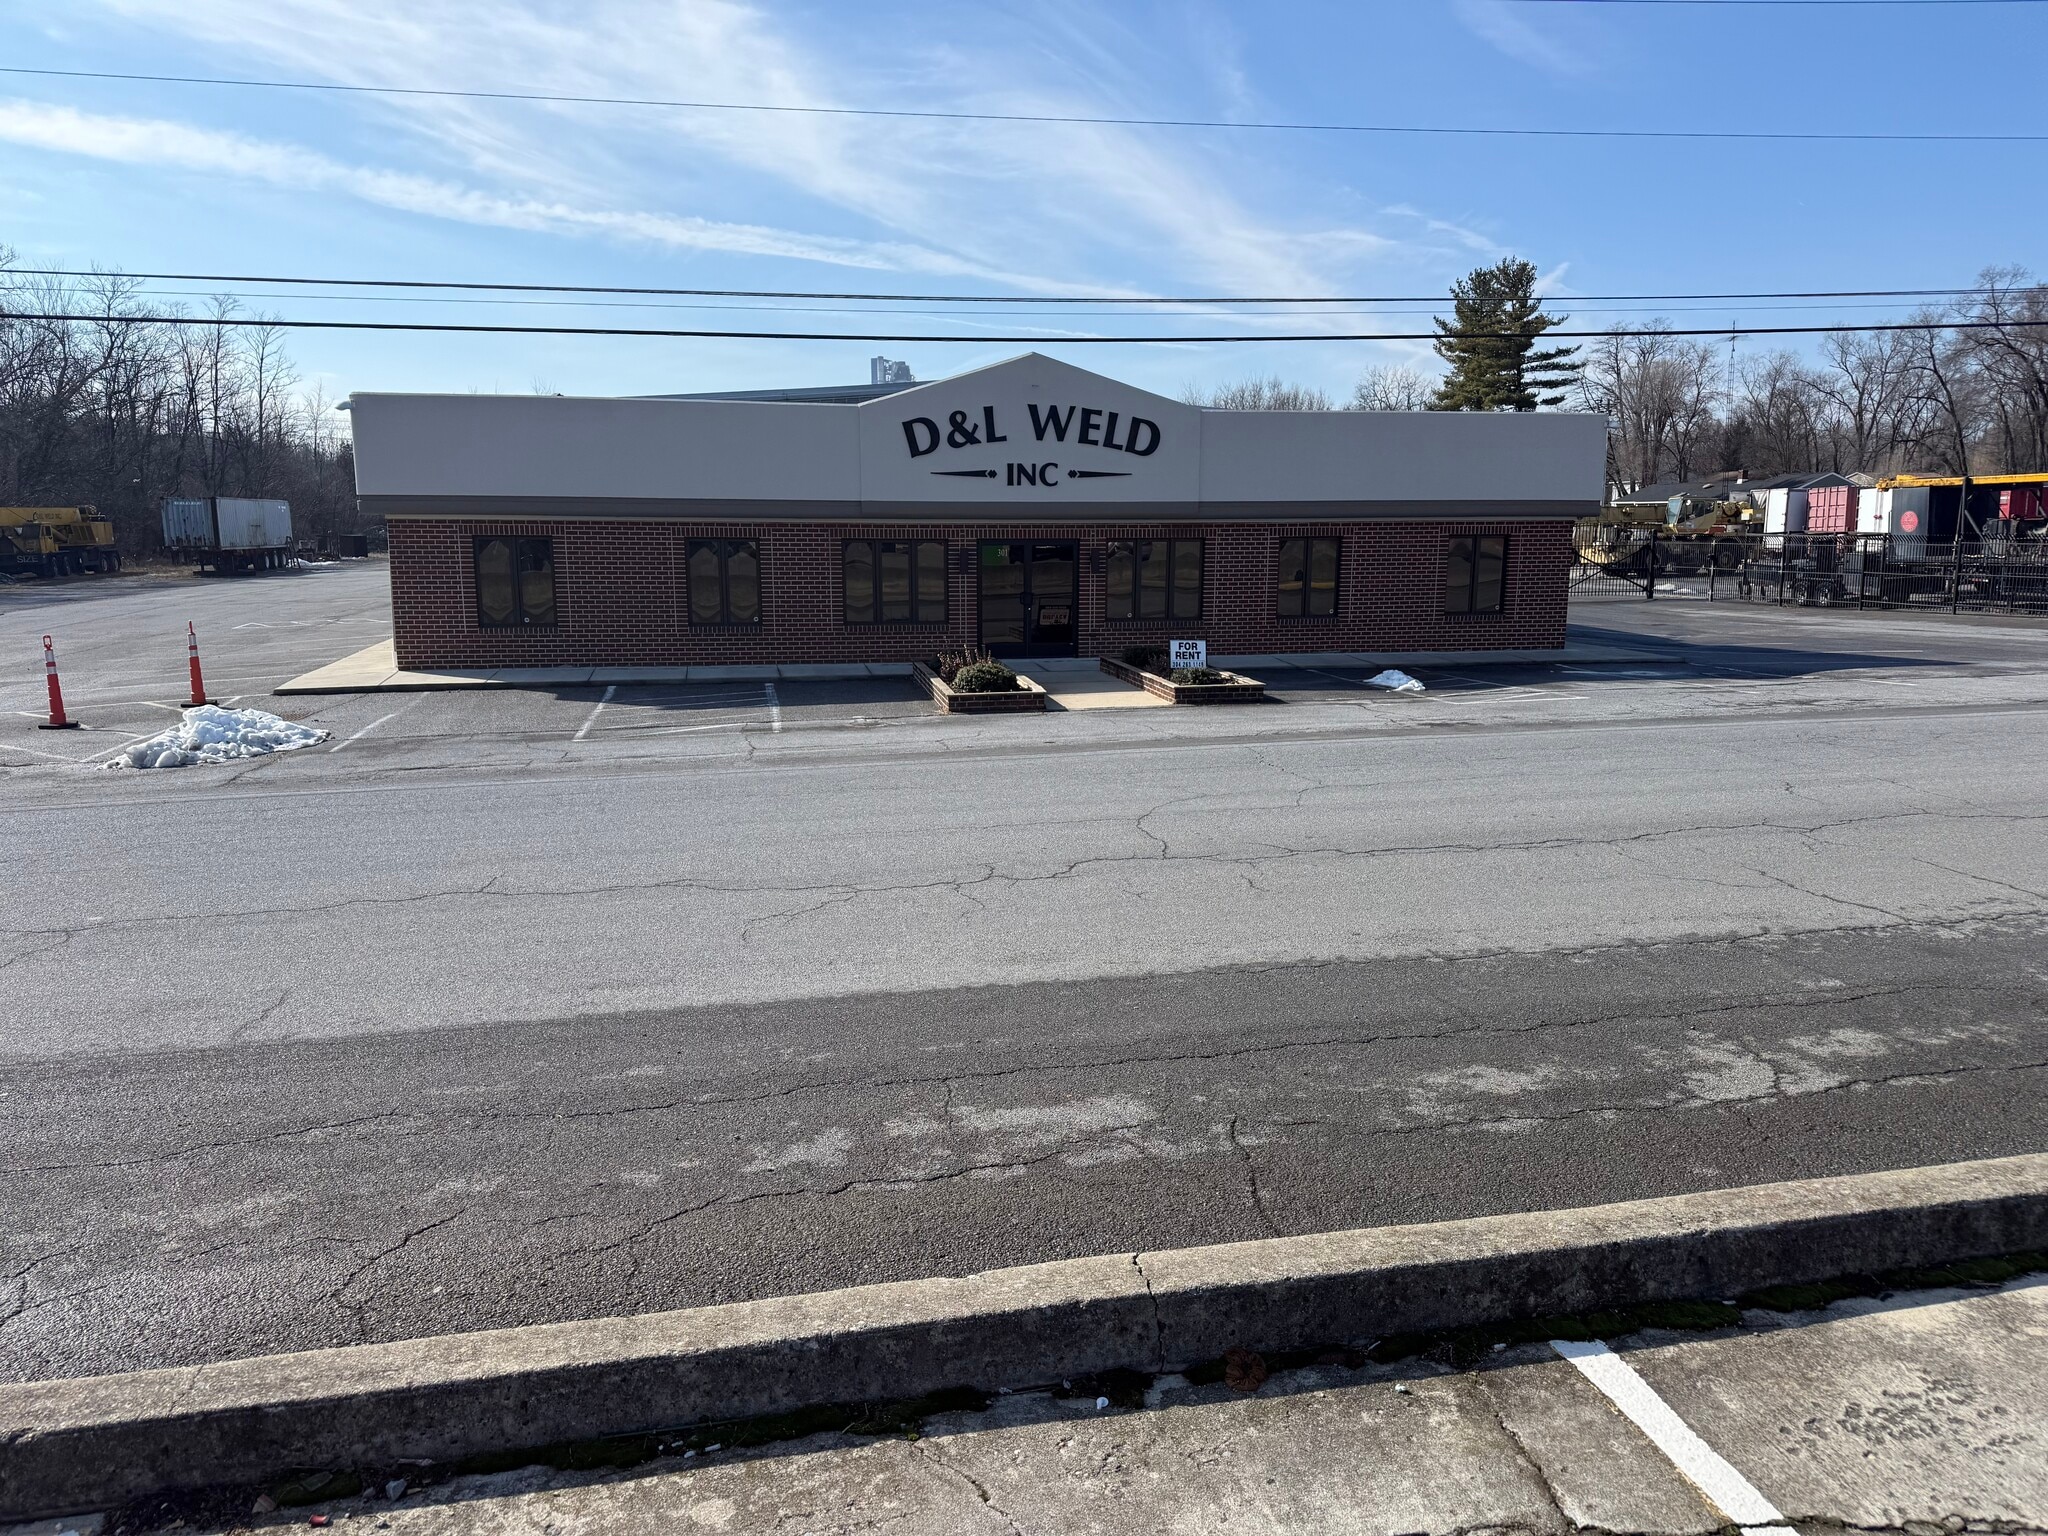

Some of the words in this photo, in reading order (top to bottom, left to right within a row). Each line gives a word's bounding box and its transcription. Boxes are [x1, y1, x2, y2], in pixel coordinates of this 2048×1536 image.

[902, 405, 1007, 458] D&L
[1027, 404, 1161, 456] WELD
[1006, 462, 1059, 487] INC
[16, 555, 38, 563] SIZE
[1178, 642, 1198, 650] FOR
[1175, 651, 1201, 660] RENT
